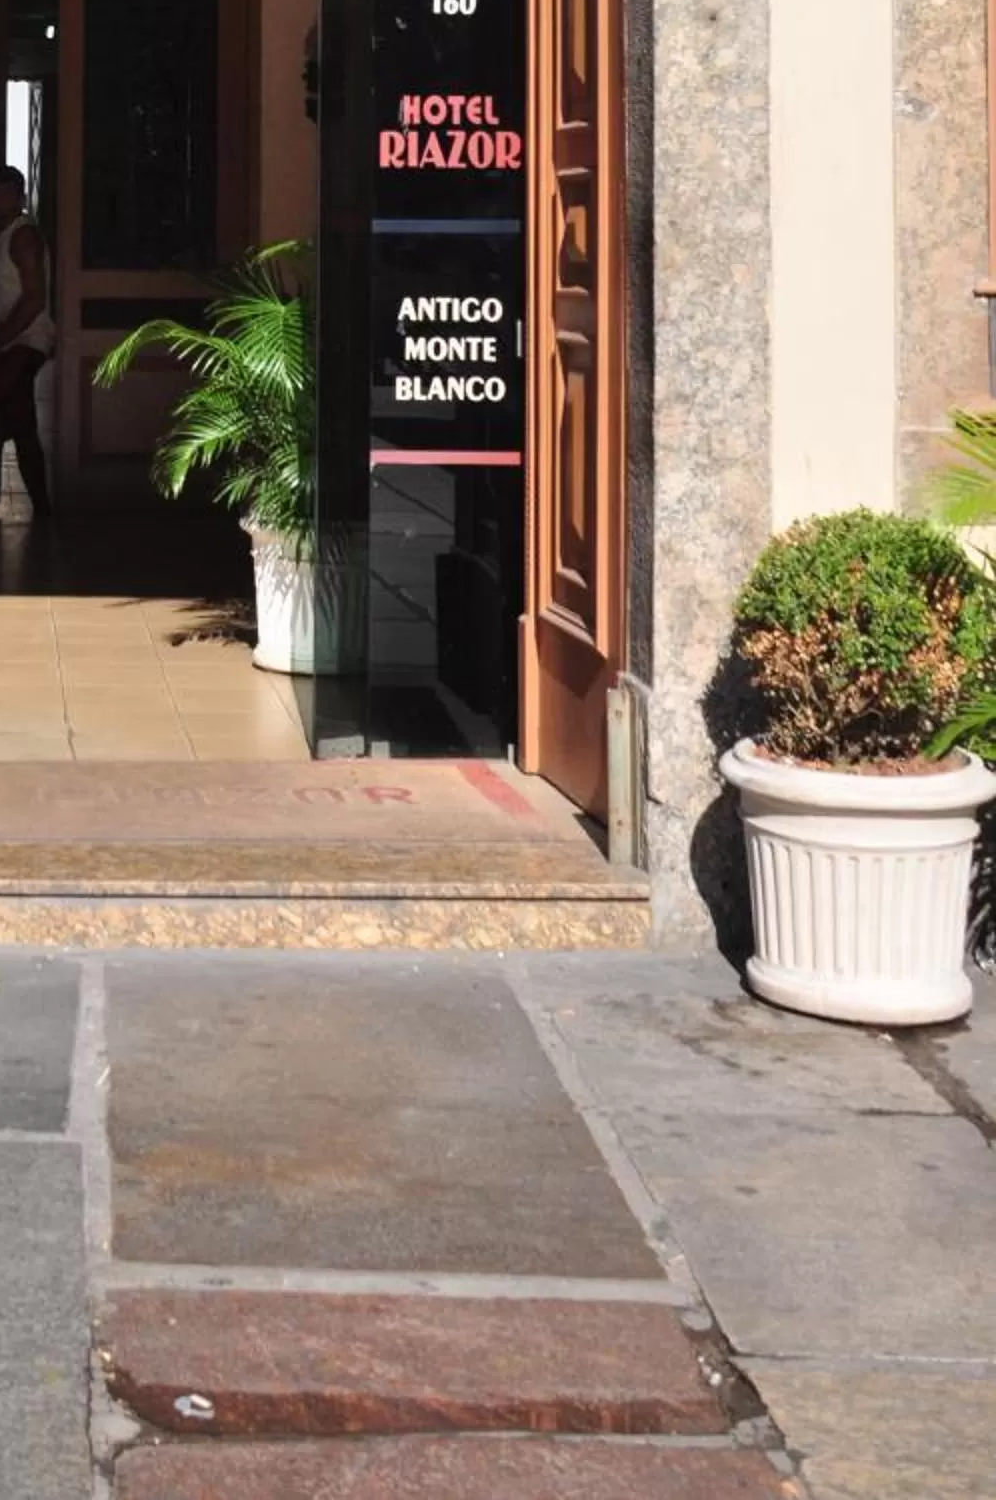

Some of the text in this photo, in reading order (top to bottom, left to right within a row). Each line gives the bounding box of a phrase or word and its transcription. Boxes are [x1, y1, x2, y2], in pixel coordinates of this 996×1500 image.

[402, 94, 500, 126] HOTEL
[379, 129, 522, 170] RIAZOR
[397, 296, 504, 323] ANTIGO
[404, 336, 497, 363] MONTE
[394, 375, 507, 402] BLANCO
